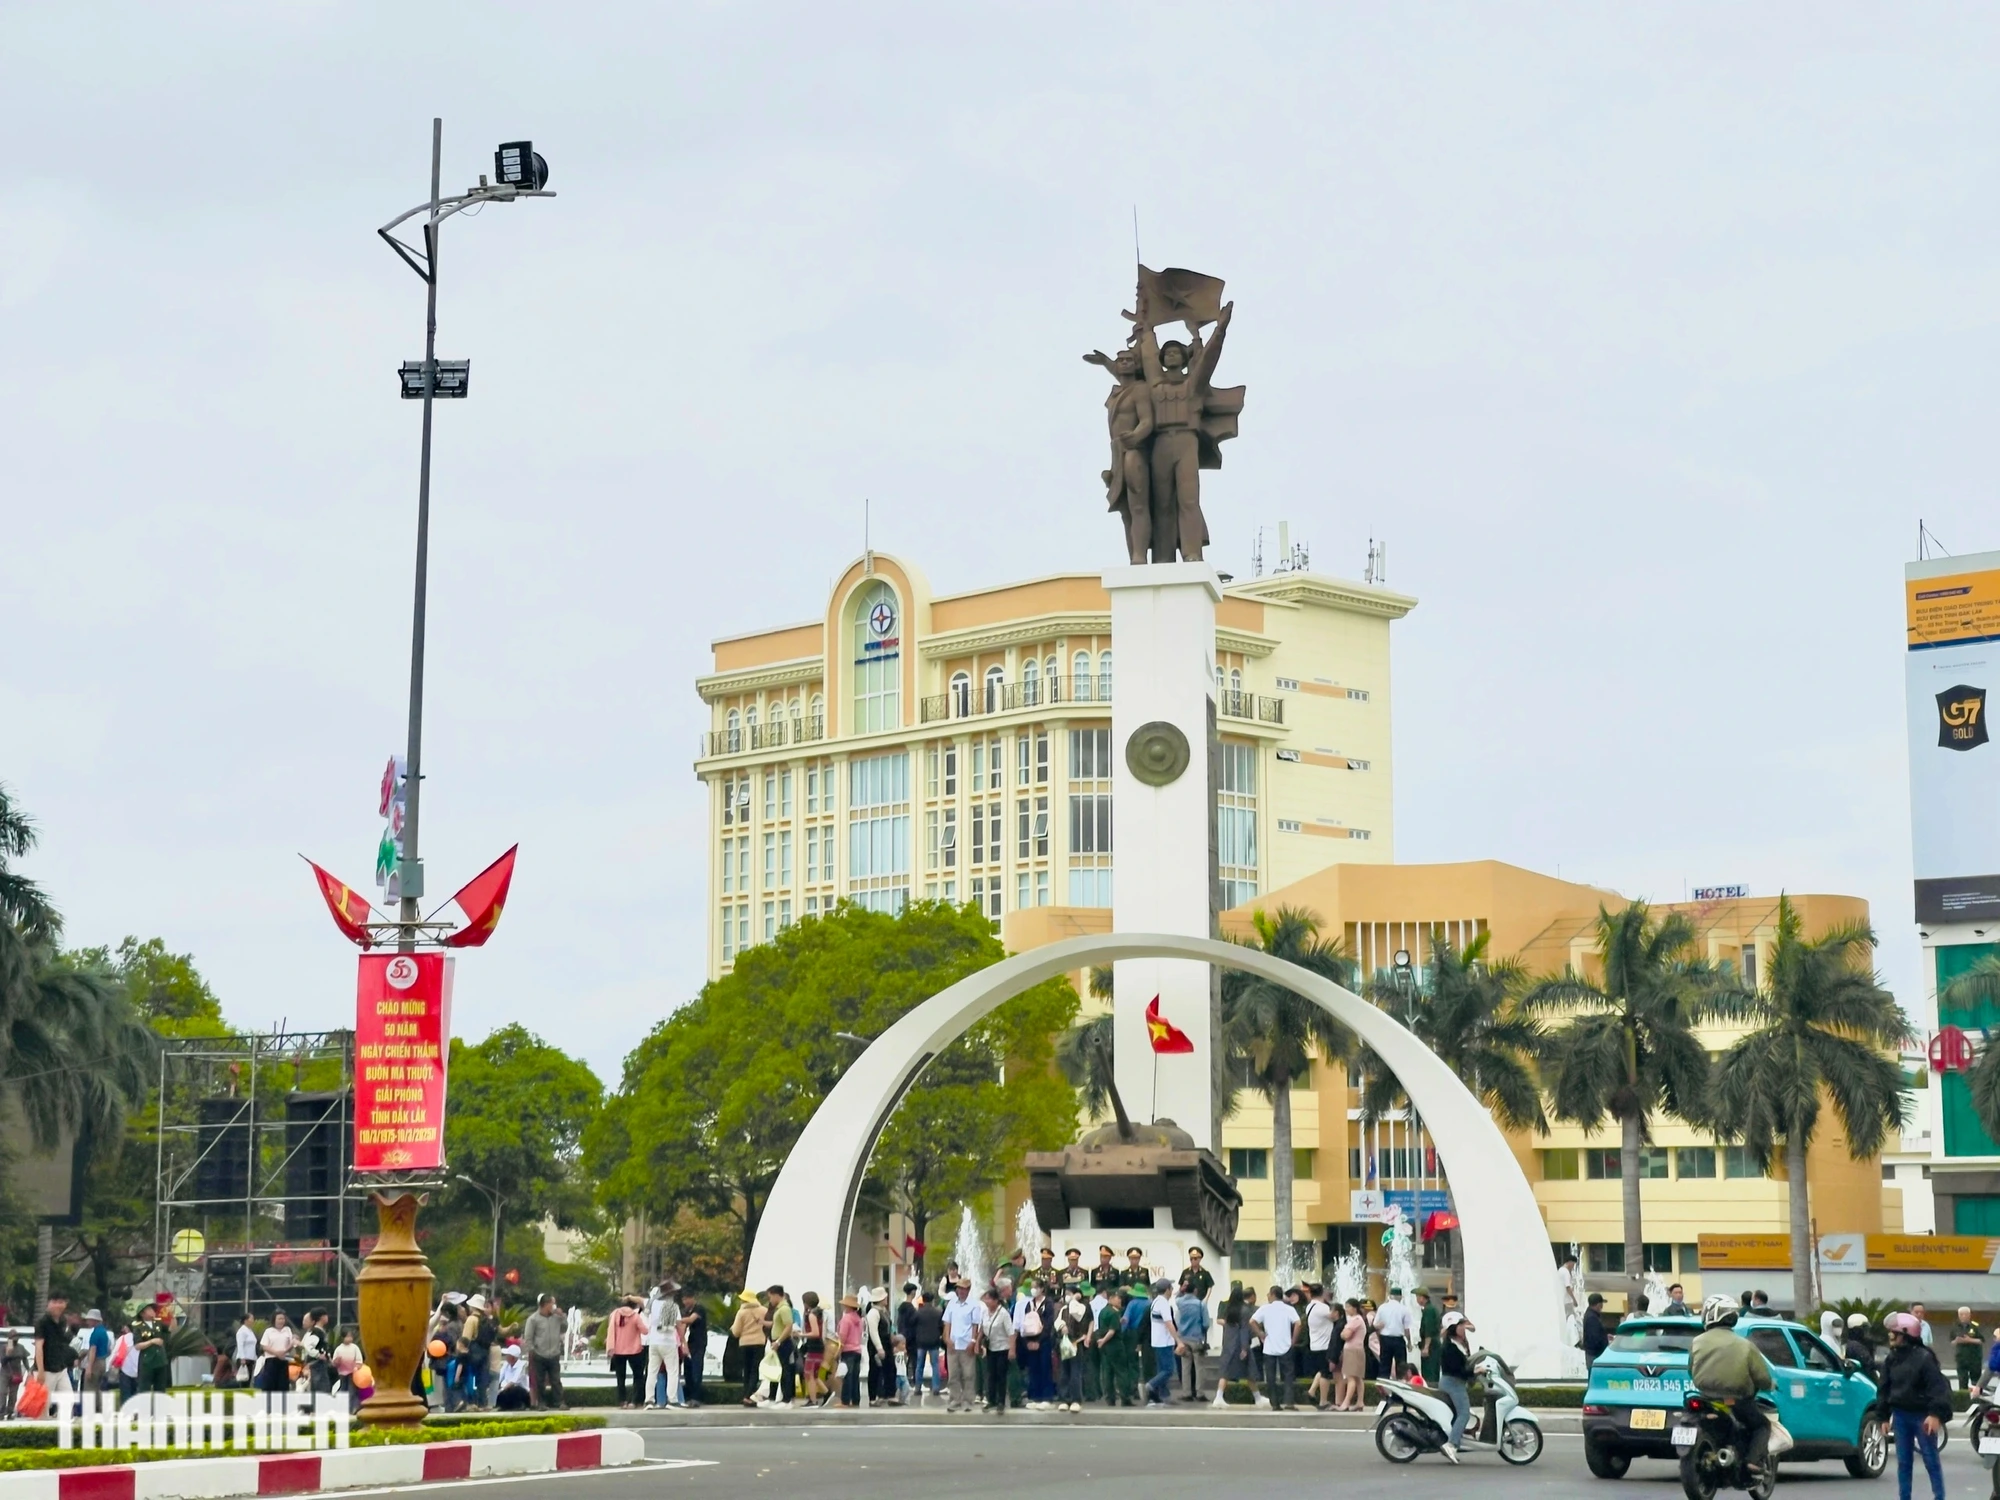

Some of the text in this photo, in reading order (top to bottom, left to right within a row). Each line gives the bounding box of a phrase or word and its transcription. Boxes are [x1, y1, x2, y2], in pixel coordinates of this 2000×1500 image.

[1942, 698, 1981, 726] G7
[1953, 727, 1974, 740] GOLD
[1695, 886, 1746, 900] HOTEL
[376, 1000, 426, 1015] CHÀO MỪNG
[385, 1021, 418, 1037] 50 NĂM
[361, 1039, 438, 1059] NGÀY CHIẾN THẮNG
[366, 1065, 389, 1081] BUÔN
[391, 1066, 405, 1080] MA
[376, 1085, 424, 1102] GIẢI PHÓNG
[372, 1105, 427, 1124] TỈNH ĐẮK LẮK
[1633, 1379, 1660, 1391] 02623
[1663, 1379, 1681, 1391] 545
